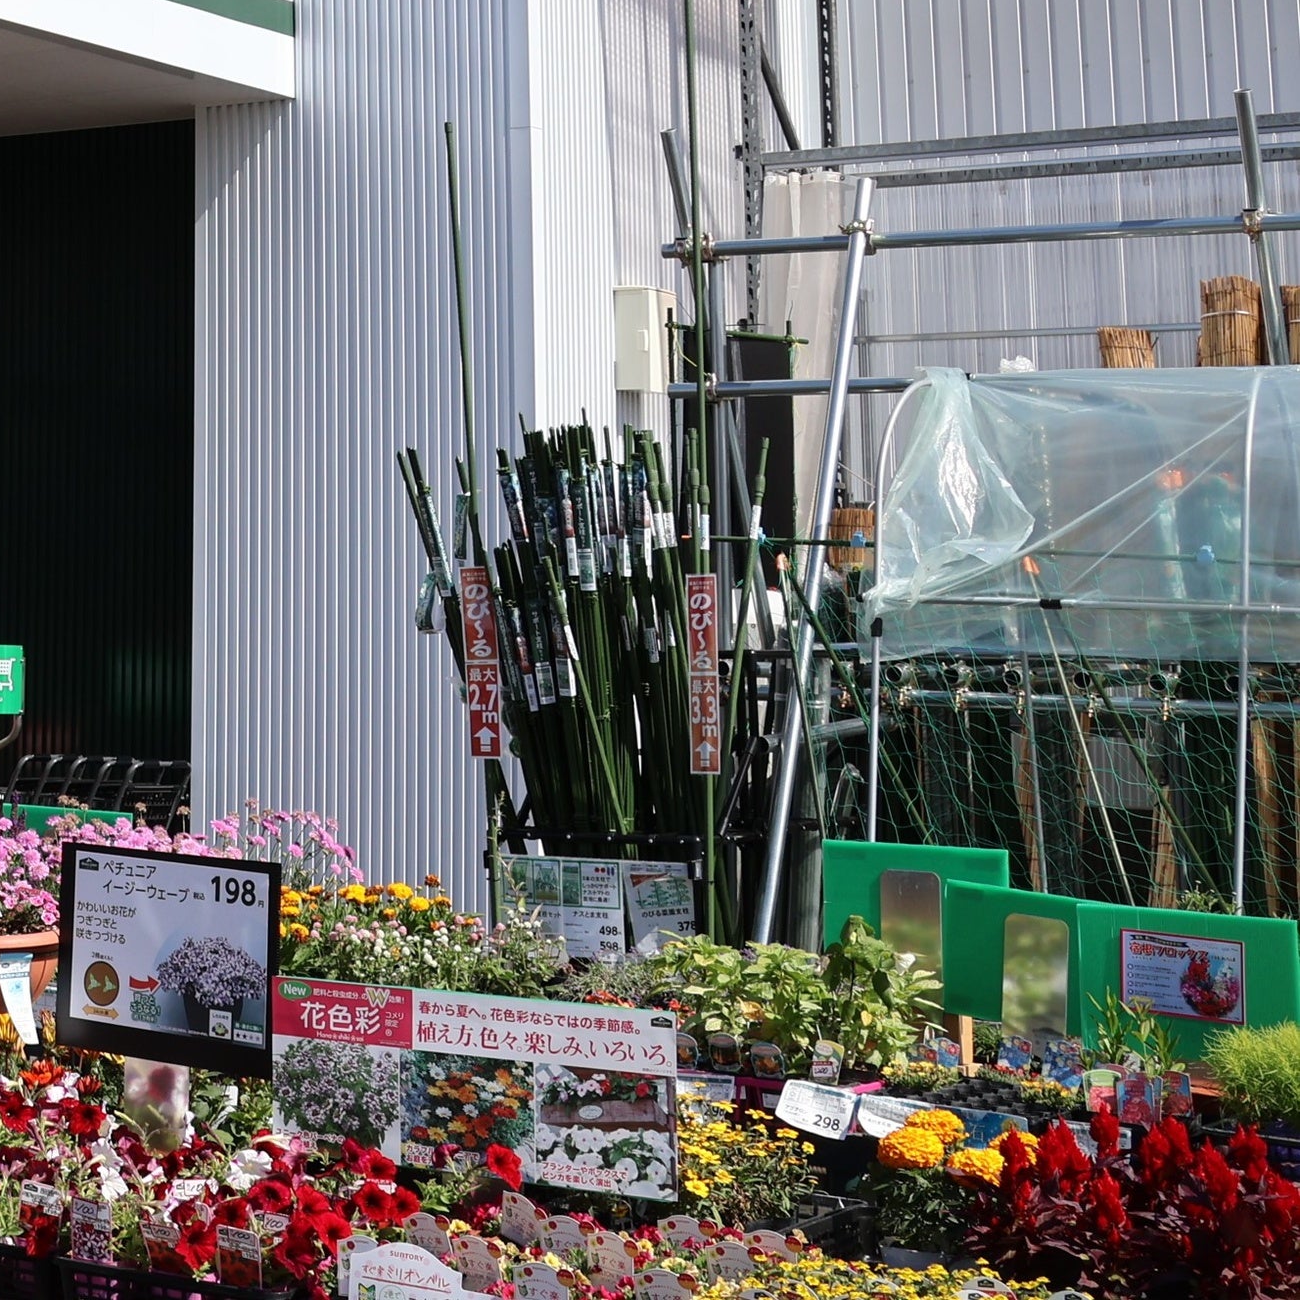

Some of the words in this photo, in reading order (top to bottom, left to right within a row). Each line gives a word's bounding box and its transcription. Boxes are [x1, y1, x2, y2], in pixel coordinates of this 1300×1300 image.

[468, 668, 496, 682] 最大
[692, 680, 714, 694] 最大
[103, 861, 157, 880] ペチュニア
[102, 879, 190, 903] イージーウェーブ
[76, 900, 137, 919] かわいいお花が
[76, 915, 118, 930] つぎつぎと
[677, 920, 696, 932] 378
[75, 927, 126, 945] 咲きつづける
[599, 926, 618, 936] 498
[283, 983, 307, 996] New
[300, 1000, 381, 1035] 花色彩
[385, 1011, 404, 1020] コメリ
[418, 1000, 642, 1035] 春から夏へ。花色彩ならではの季節感。
[417, 1021, 672, 1067] 植え方、色々。楽しみ、いろいろ。
[812, 1113, 841, 1131] 298
[542, 1161, 627, 1180] プランターやボックスで
[542, 1171, 612, 1188] ビンカを楽しく演出
[389, 1250, 425, 1262] SUNTORY
[600, 1255, 626, 1271] すぐ楽
[468, 1258, 493, 1272] すぐ楽
